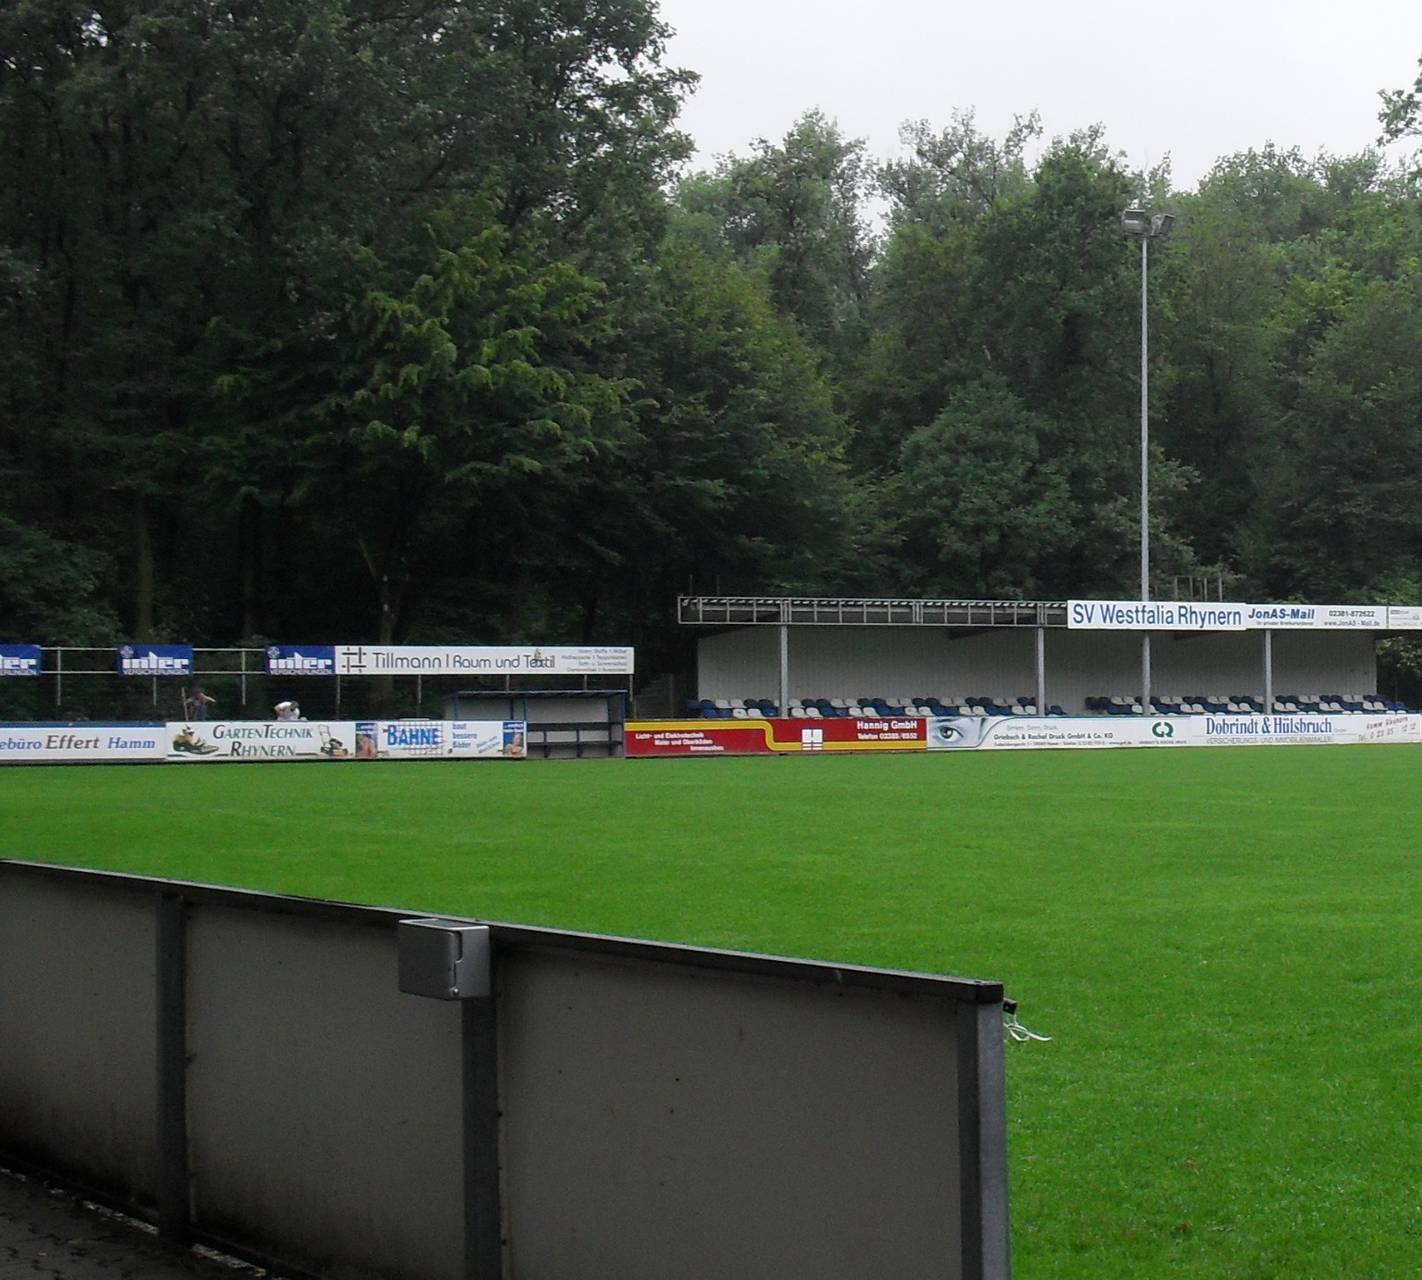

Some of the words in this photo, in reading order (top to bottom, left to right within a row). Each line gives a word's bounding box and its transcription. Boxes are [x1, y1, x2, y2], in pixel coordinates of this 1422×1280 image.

[1073, 603, 1095, 624] SV
[1100, 603, 1174, 625] Westfalia
[1178, 605, 1242, 628] Rhynern
[1248, 608, 1315, 620] JonAS-Mail
[122, 651, 189, 669] inter
[270, 652, 333, 669] inter
[372, 652, 442, 669] Tillmann
[453, 655, 491, 669] Raum
[496, 654, 520, 669] und
[523, 654, 556, 669] Textil
[857, 720, 889, 730] Hannig
[891, 720, 918, 729] GmbH
[1206, 716, 1259, 735] Dobrindt
[1262, 716, 1271, 734] &
[1274, 716, 1332, 734] Hülsbruch
[46, 735, 100, 750] Effert
[108, 737, 155, 749] Hamm
[387, 724, 440, 746] BAHNE
[857, 732, 878, 740] Telefon
